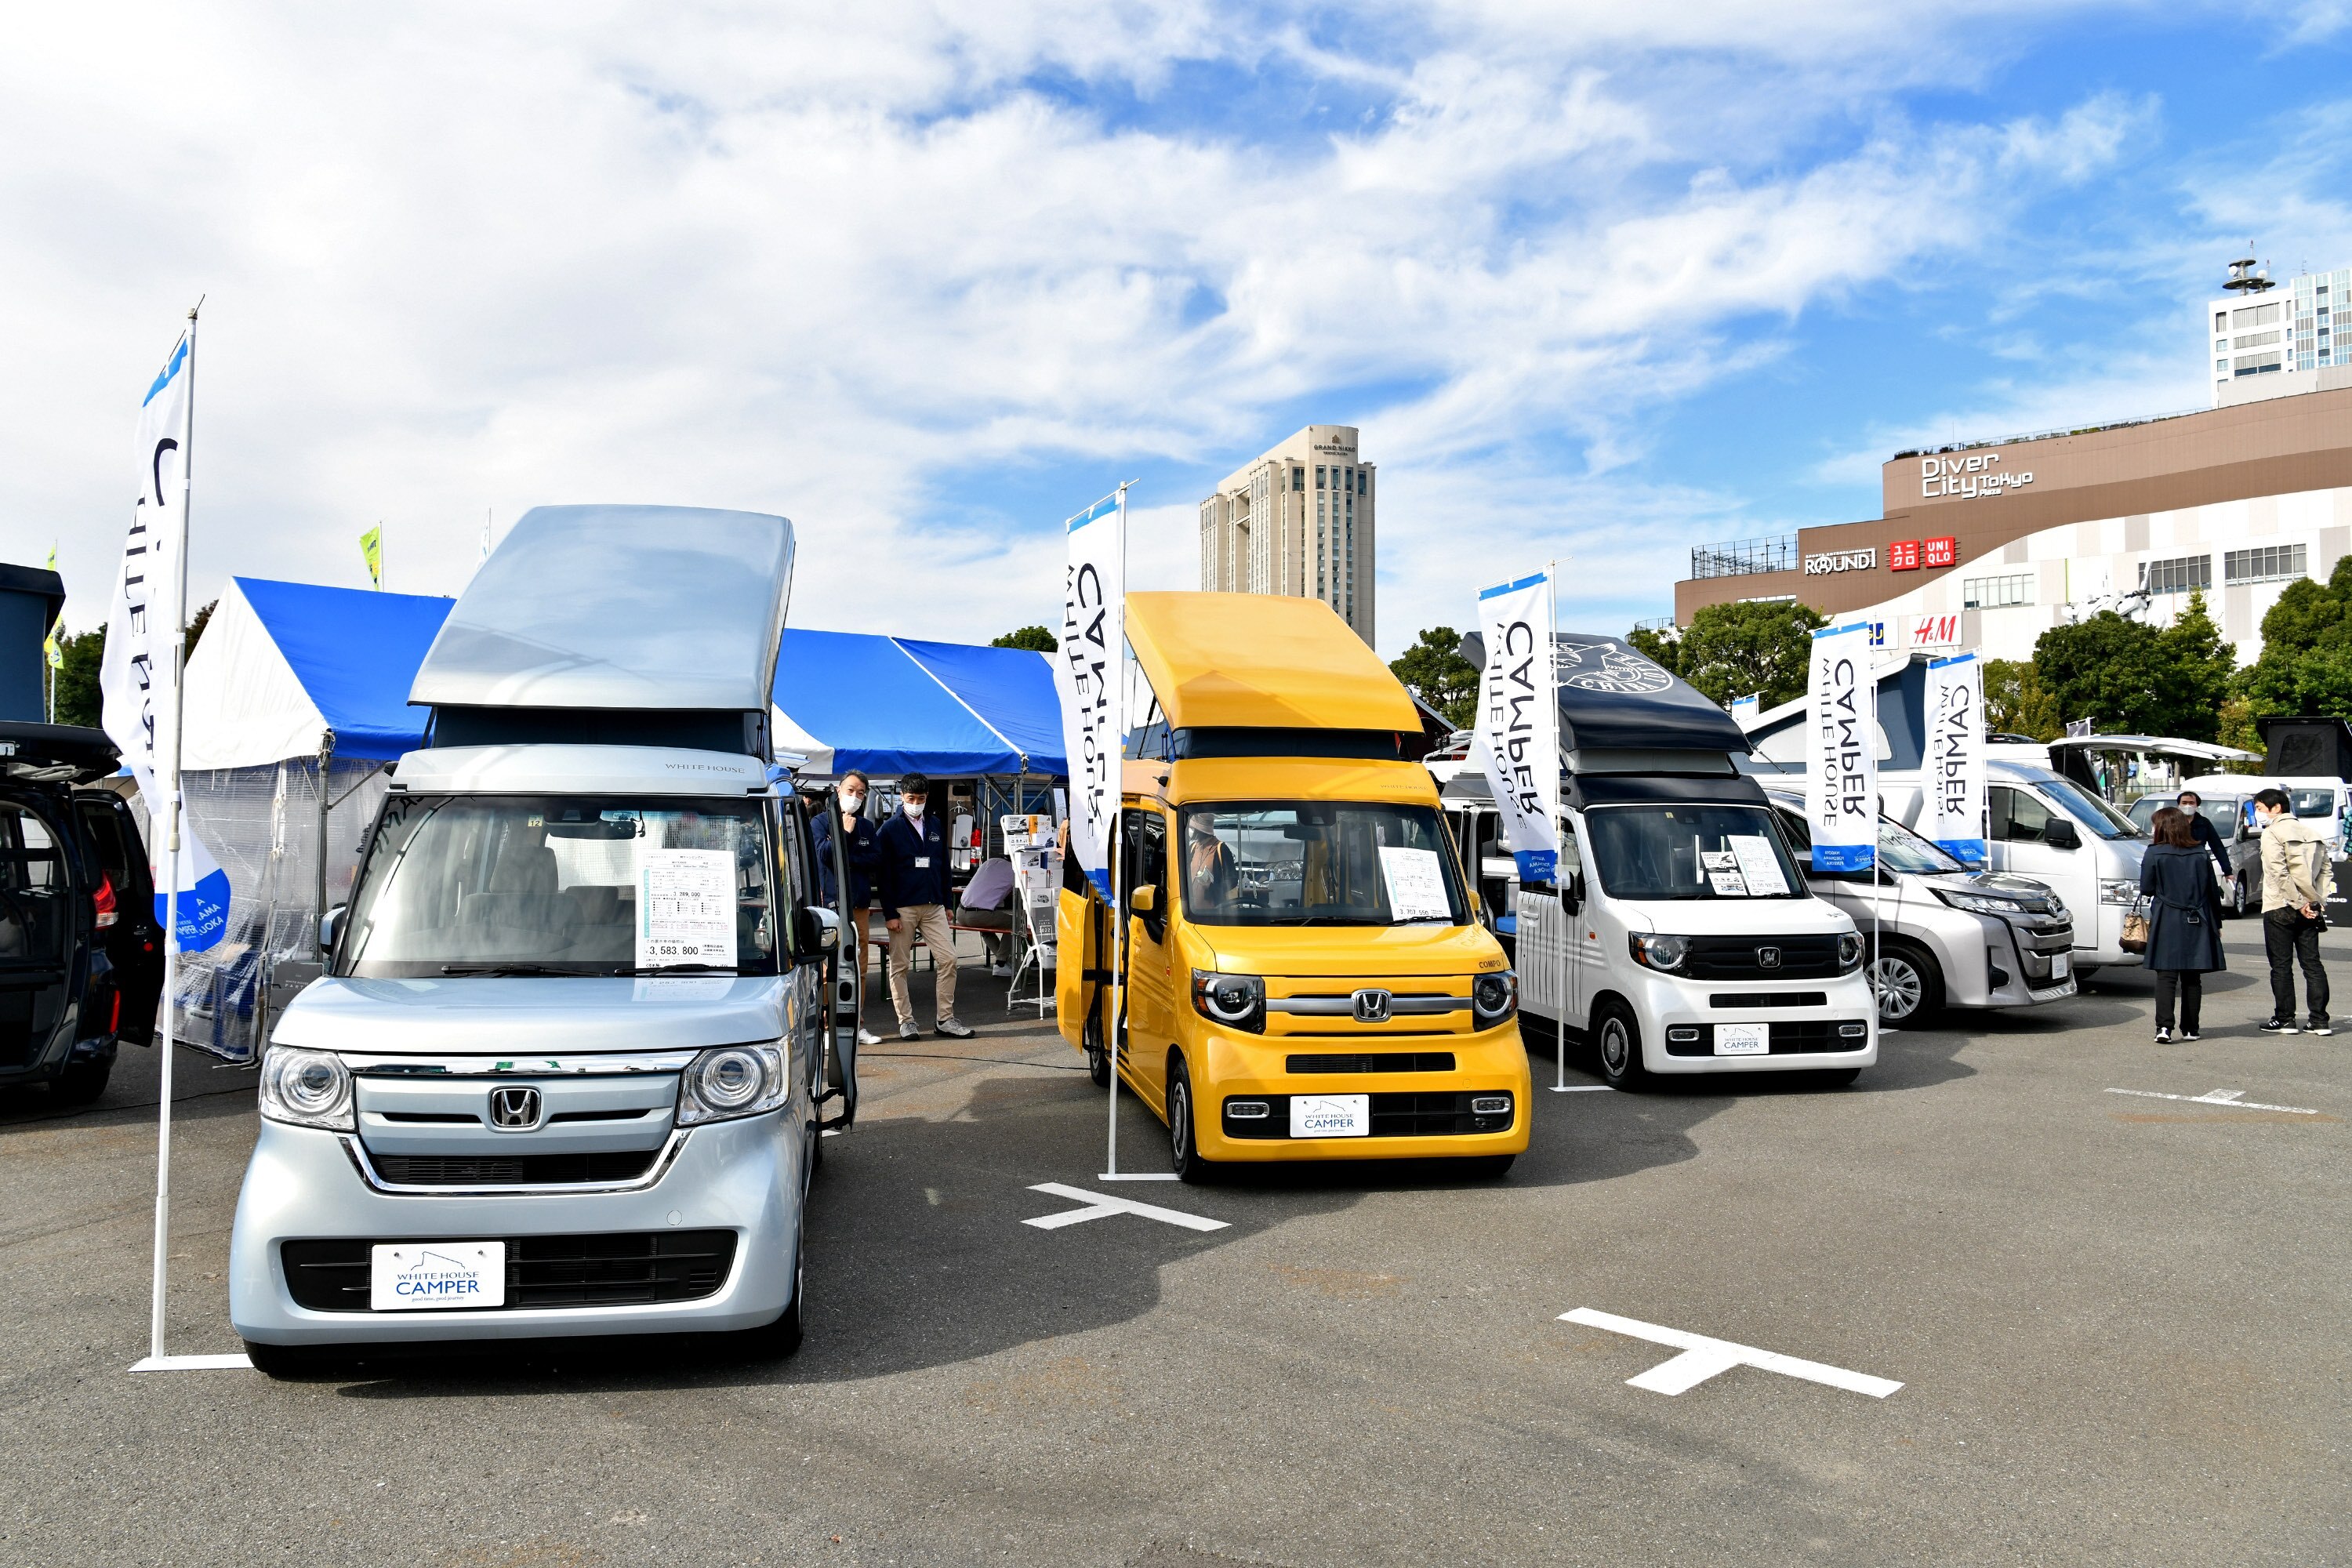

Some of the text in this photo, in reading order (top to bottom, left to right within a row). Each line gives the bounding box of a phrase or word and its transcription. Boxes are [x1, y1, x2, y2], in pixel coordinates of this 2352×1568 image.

[1922, 453, 1999, 478] Diver
[1922, 475, 1977, 499] City
[1927, 540, 1948, 552] UNI
[1927, 551, 1951, 564] QLO
[1915, 615, 1957, 644] H&M
[707, 765, 745, 774] HOUSE
[1479, 960, 1501, 968] COMPO
[1305, 1119, 1355, 1129] CAMPER
[396, 1279, 480, 1295] CAMPER
